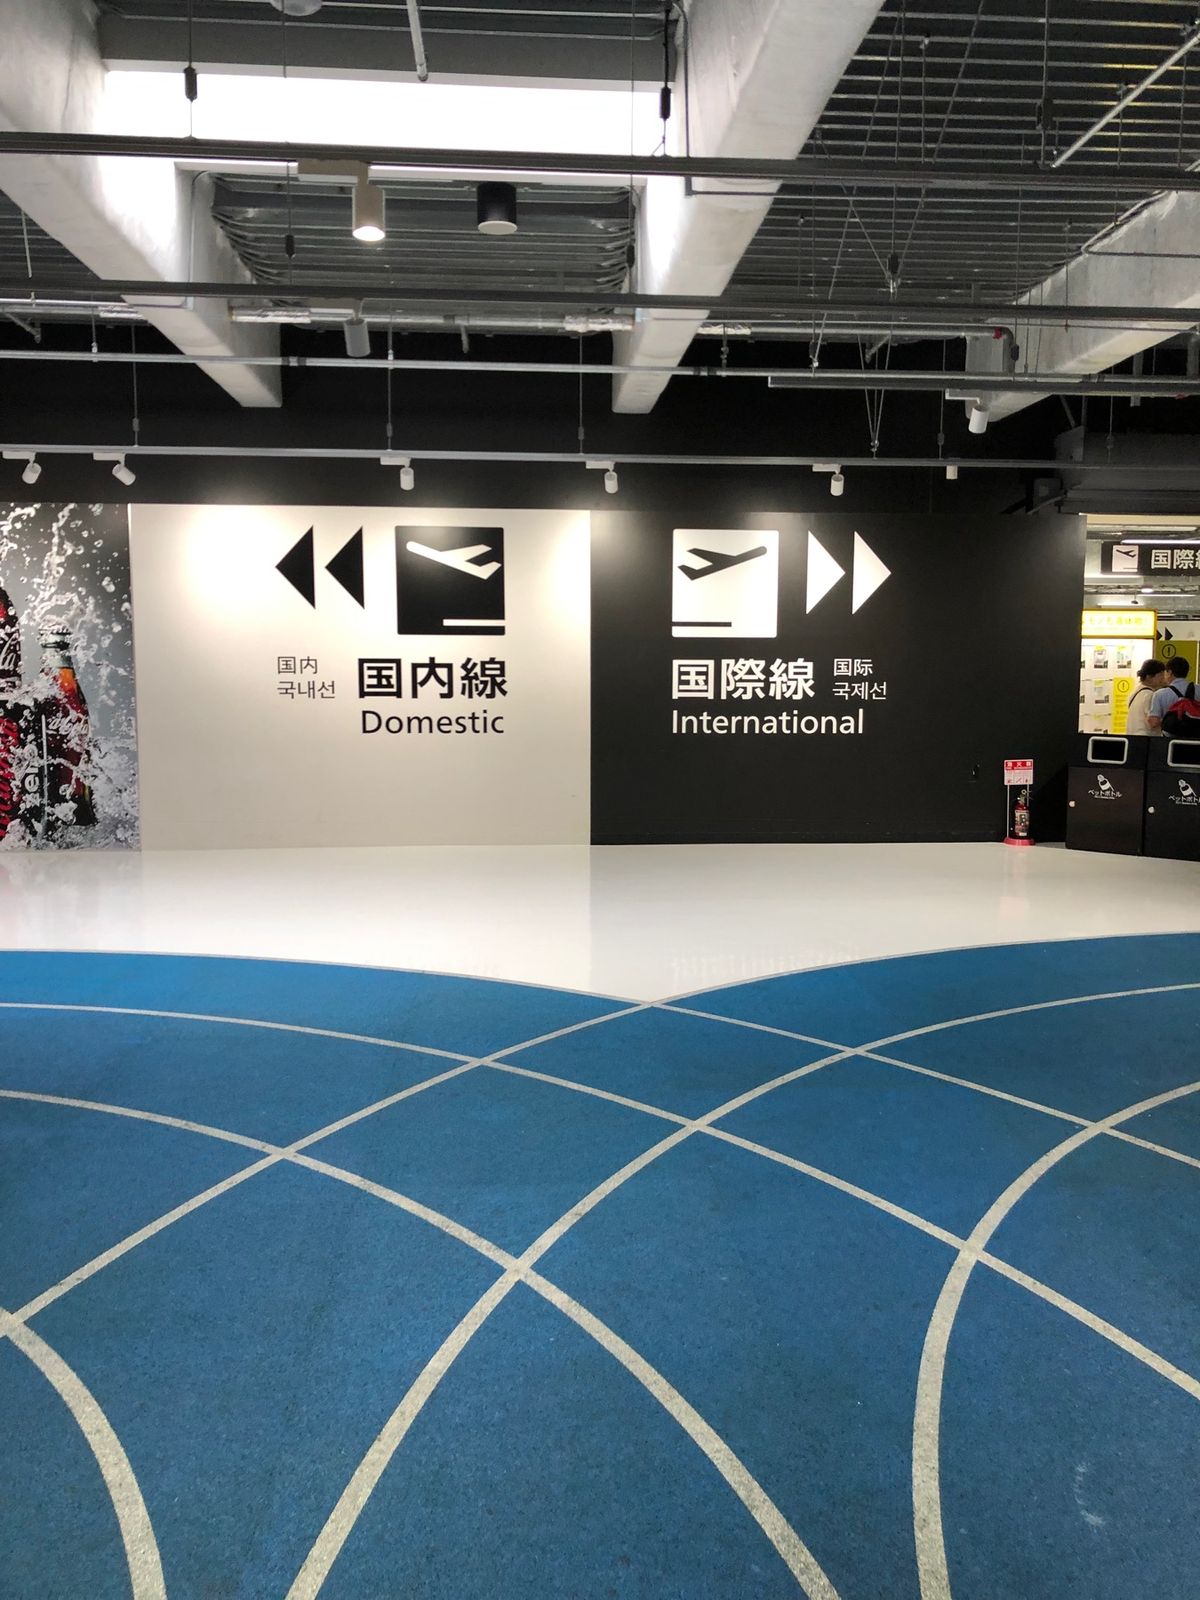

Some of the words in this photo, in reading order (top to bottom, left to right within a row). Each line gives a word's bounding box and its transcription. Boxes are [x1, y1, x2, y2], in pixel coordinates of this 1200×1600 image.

[1151, 548, 1200, 570] 国際
[277, 656, 318, 675] 国内
[833, 658, 873, 677] 国际
[358, 656, 508, 700] 国内線
[671, 658, 816, 701] 国際線
[277, 680, 336, 700] 국내선
[832, 681, 887, 701] 국제선
[361, 709, 505, 735] Domestic
[671, 708, 864, 735] International
[1168, 795, 1200, 804] ペットボト
